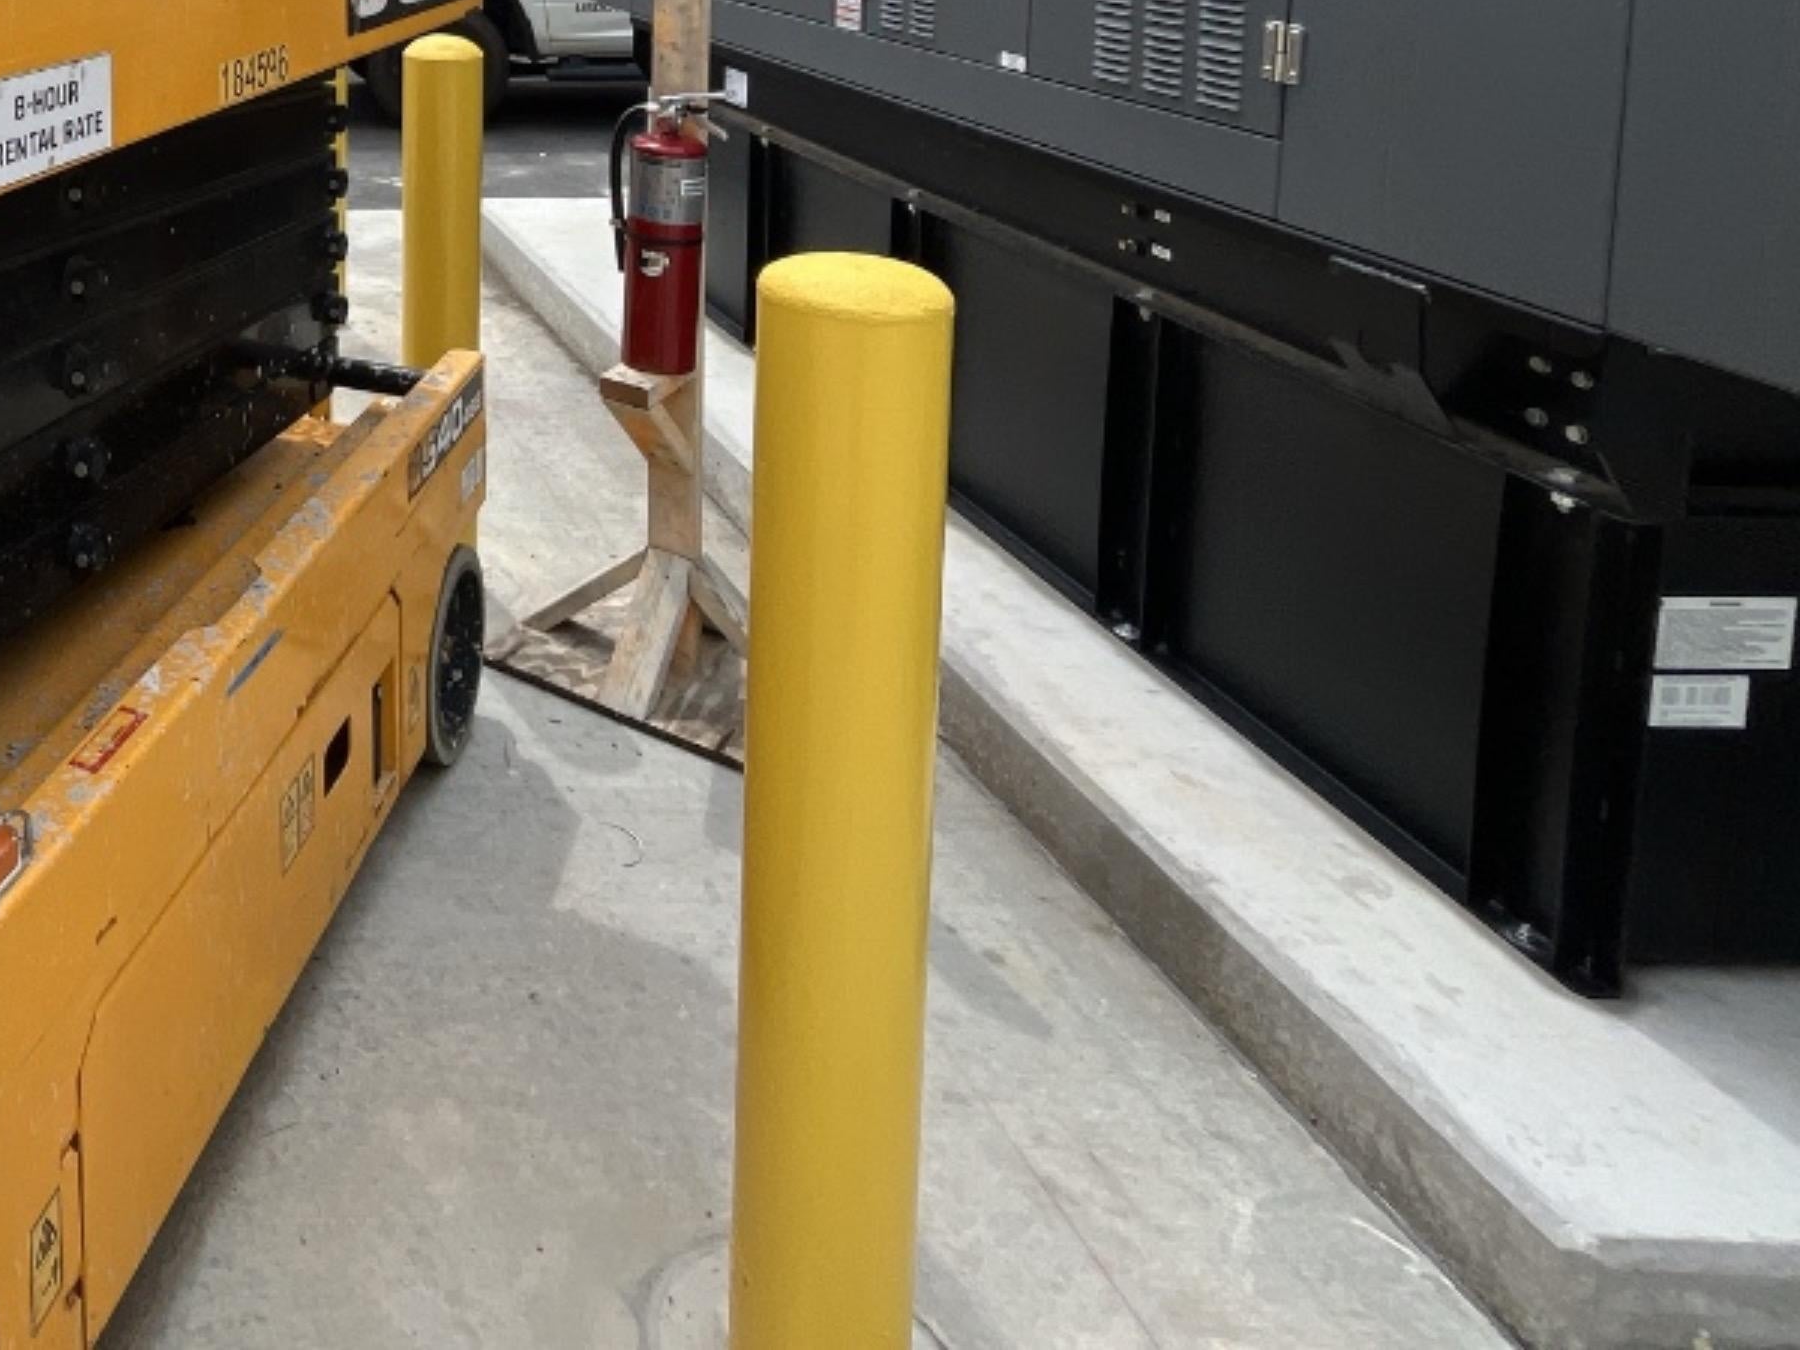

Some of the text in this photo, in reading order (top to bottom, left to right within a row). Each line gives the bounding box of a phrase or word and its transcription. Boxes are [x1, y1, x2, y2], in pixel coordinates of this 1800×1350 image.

[219, 43, 290, 100] 184596
[13, 79, 80, 120] 8-HOUR
[62, 111, 104, 144] RATE
